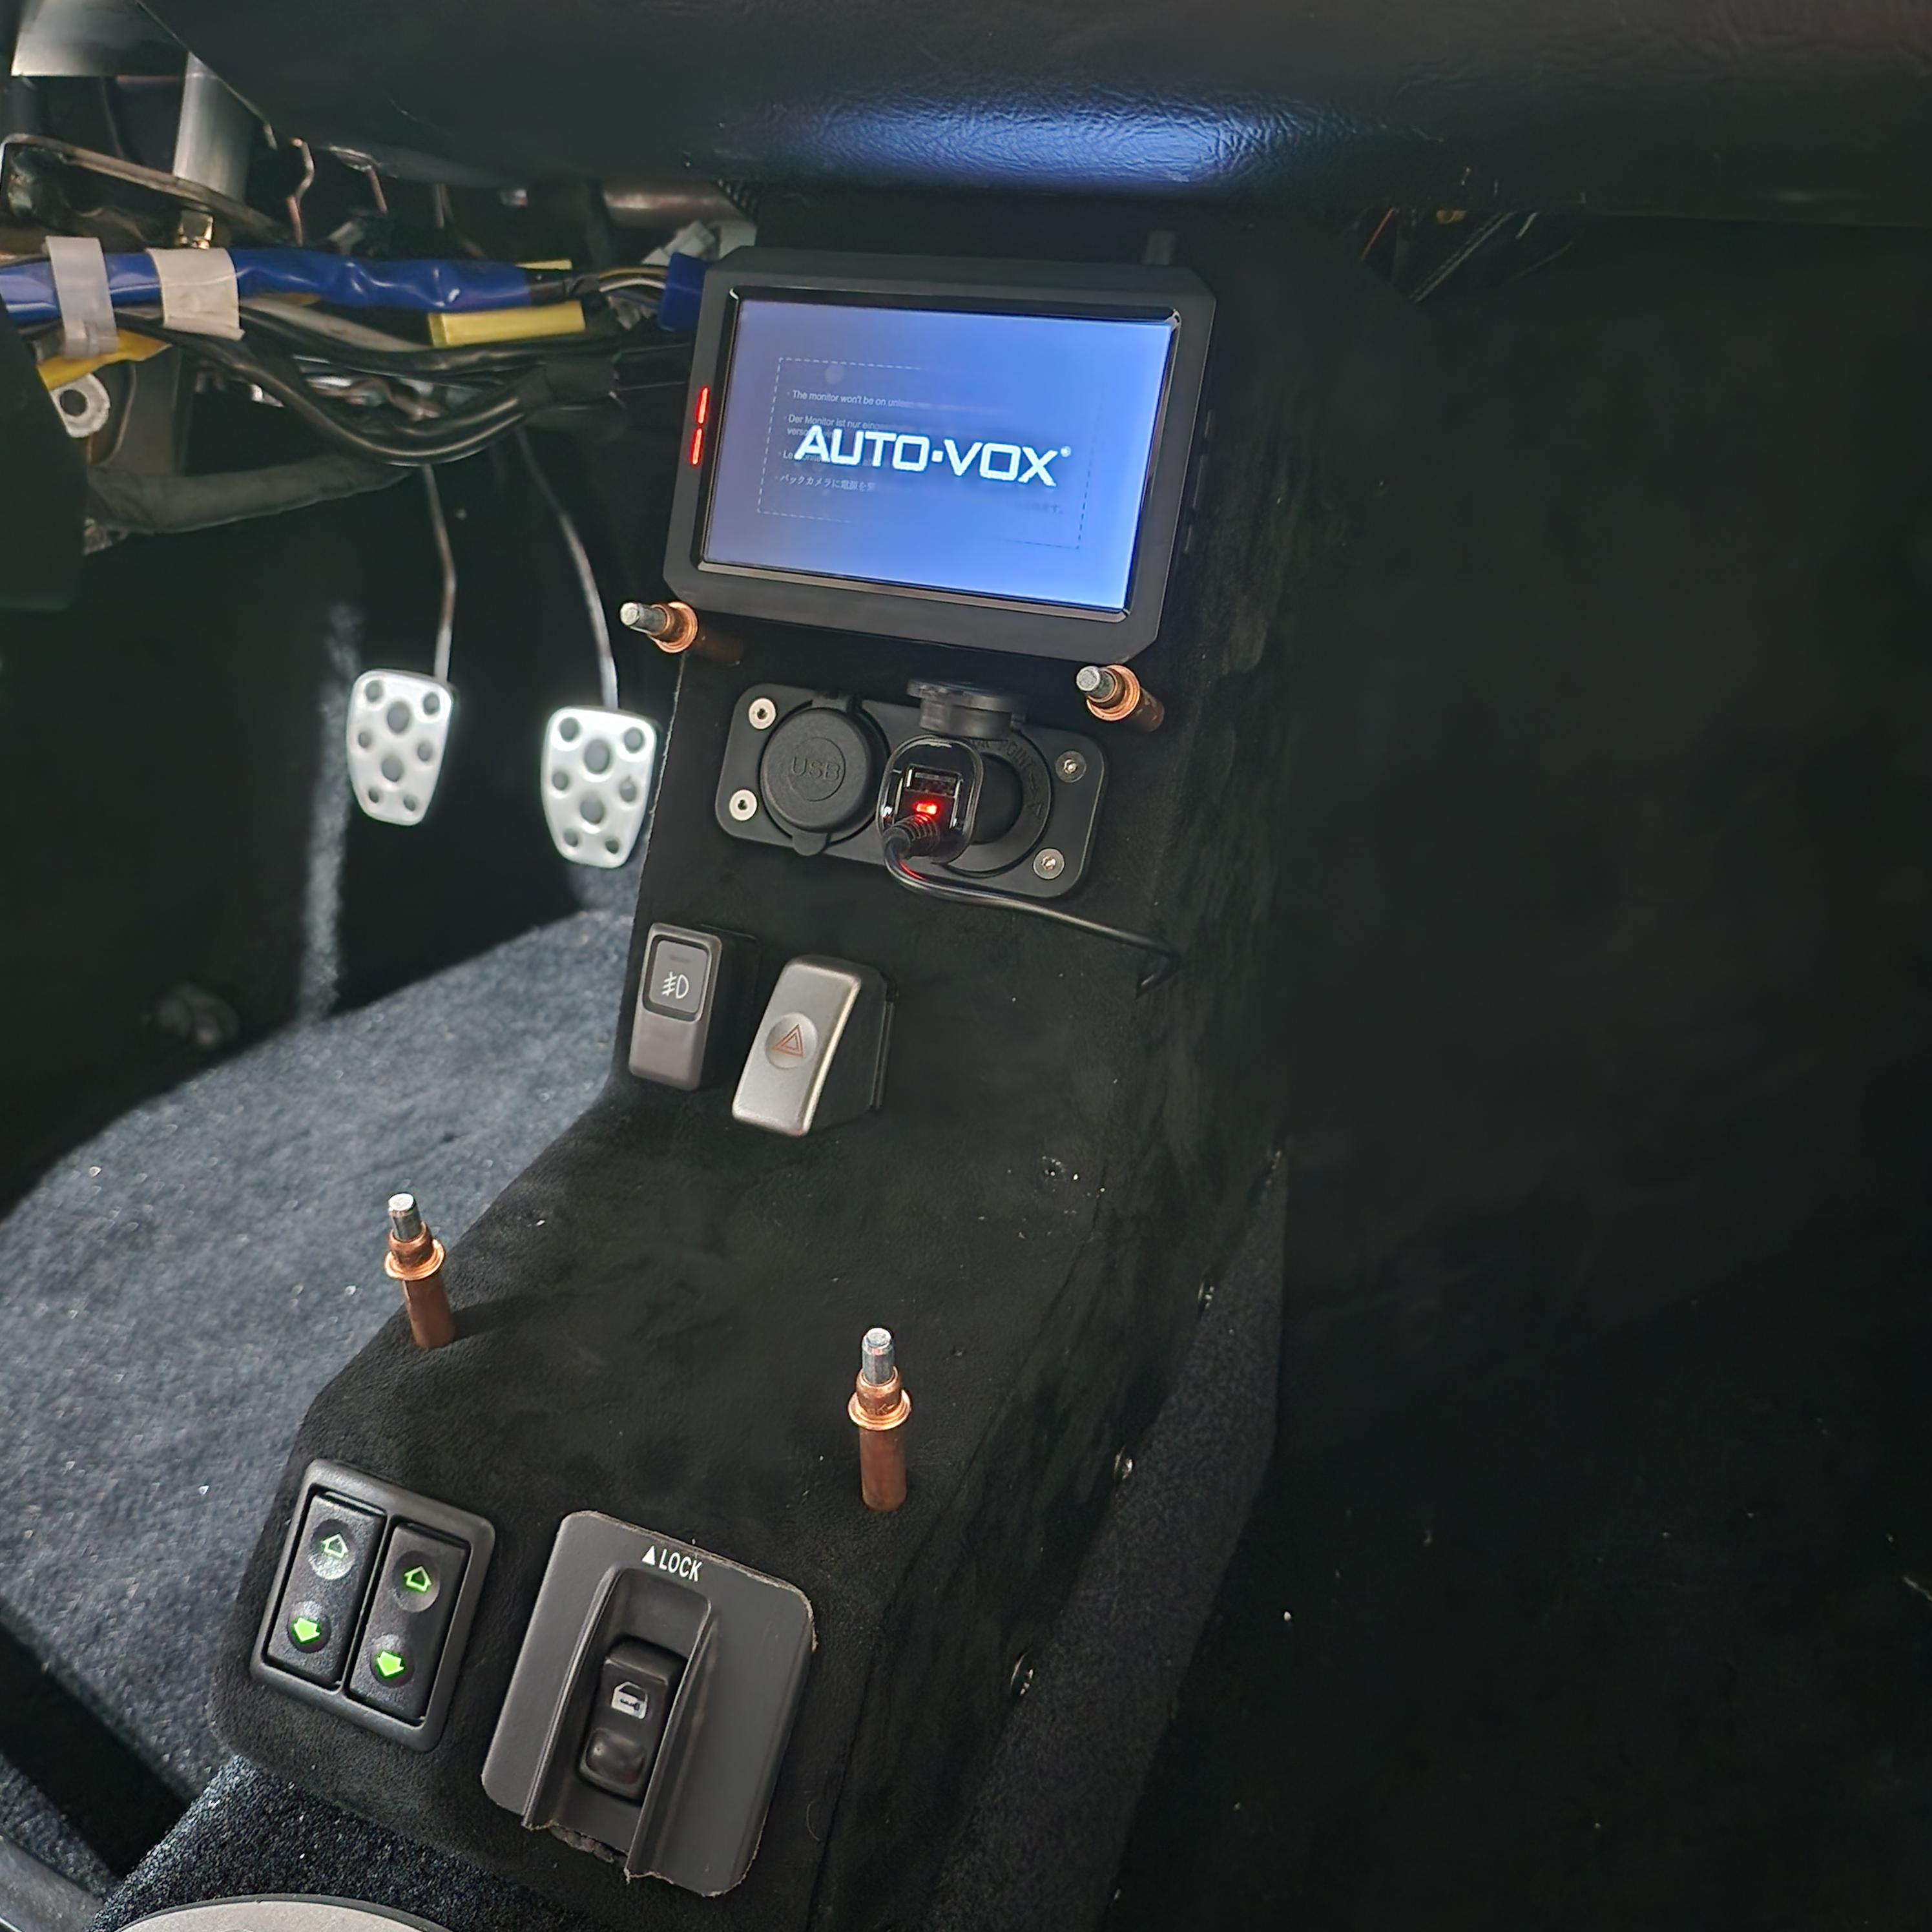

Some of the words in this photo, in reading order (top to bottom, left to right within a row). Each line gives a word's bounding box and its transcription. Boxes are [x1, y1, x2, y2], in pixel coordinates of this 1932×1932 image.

[792, 390, 807, 400] The
[809, 392, 839, 402] monitor
[840, 394, 862, 404] won't
[863, 395, 875, 406] be
[875, 397, 887, 406] on
[788, 414, 804, 424] Der
[805, 415, 835, 427] Monitor
[836, 417, 846, 427] ist
[847, 421, 862, 430] nur
[790, 754, 841, 782] USB
[659, 1548, 703, 1582] LOCK
